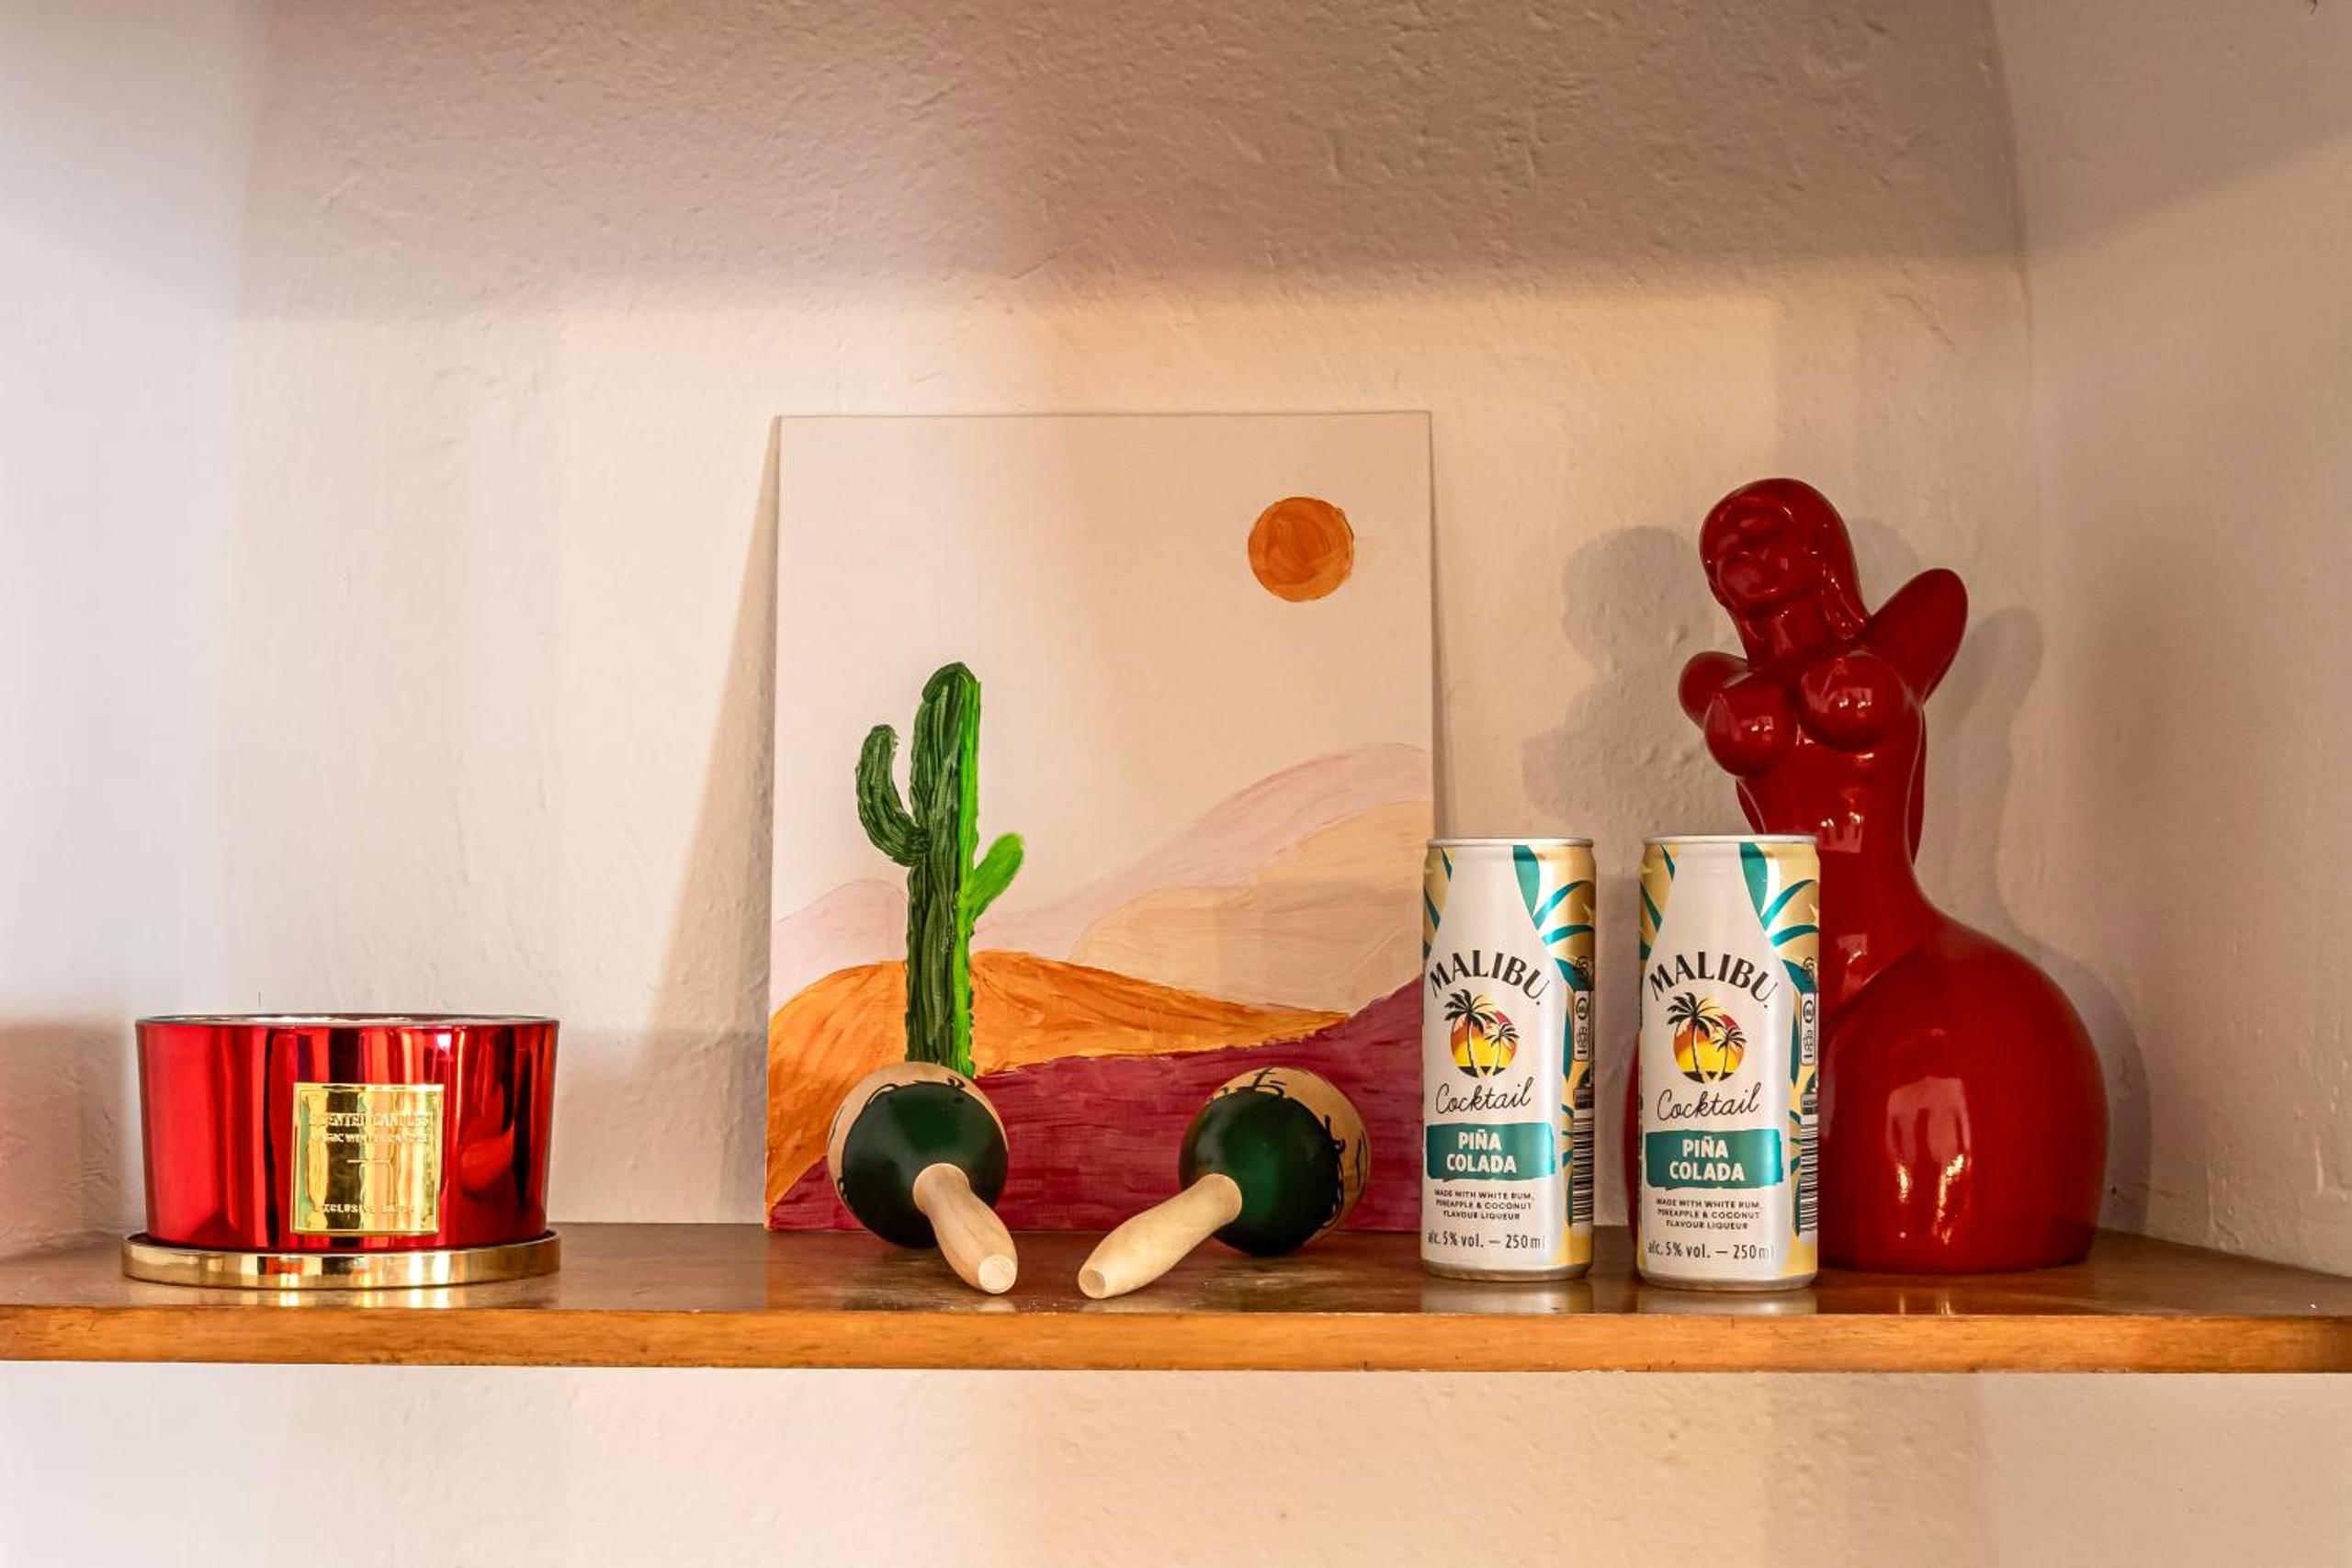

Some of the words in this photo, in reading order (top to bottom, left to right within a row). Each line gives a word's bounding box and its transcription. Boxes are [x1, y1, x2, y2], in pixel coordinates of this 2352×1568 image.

[1430, 950, 1550, 1000] MALIBU
[1649, 952, 1779, 1002] MALIBU
[1436, 1077, 1534, 1114] Cocktail
[1657, 1082, 1762, 1121] Cocktail
[1457, 1129, 1502, 1152] PIÑA
[1681, 1136, 1729, 1158] PIÑA
[1446, 1153, 1518, 1174] COLADA
[1668, 1161, 1746, 1181] COLADA
[1434, 1189, 1453, 1197] MADE
[1454, 1190, 1476, 1199] WITH
[1436, 1199, 1475, 1209] PINEAPPLE
[1485, 1201, 1532, 1210] COCONUT
[1657, 1198, 1677, 1207] MADE
[1679, 1199, 1702, 1208] WITH
[1704, 1201, 1736, 1209] WHITE
[1443, 1210, 1478, 1219] FLAVOUR
[1480, 1212, 1521, 1221] LIQUEUR
[1657, 1208, 1699, 1219] PINEAPPLE
[1702, 1211, 1708, 1219] &
[1711, 1211, 1760, 1220] COCONUT
[1666, 1219, 1705, 1229] FLAVOUR
[1707, 1222, 1749, 1230] LIQUEUR
[1461, 1233, 1484, 1248] vol.
[1686, 1243, 1711, 1258] vol.
